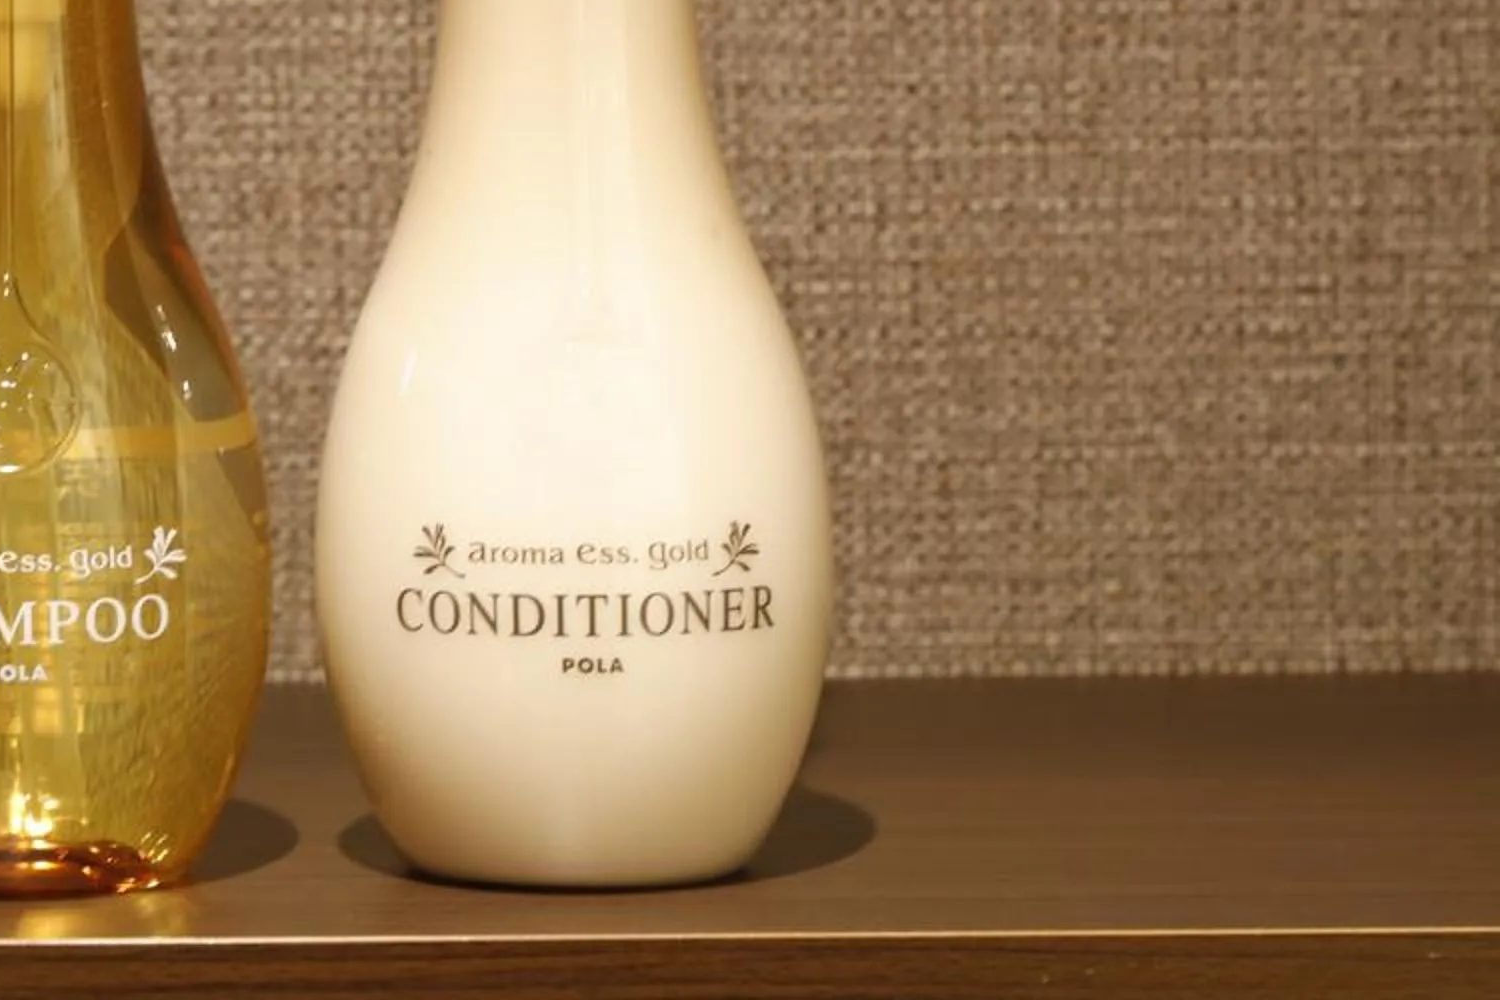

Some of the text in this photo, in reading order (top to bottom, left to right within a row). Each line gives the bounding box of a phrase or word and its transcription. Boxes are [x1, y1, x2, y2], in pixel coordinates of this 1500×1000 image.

[69, 545, 133, 578] gold
[468, 539, 710, 570] aroma ess. gold
[396, 585, 776, 638] CONDITIONER
[561, 657, 624, 674] POLA
